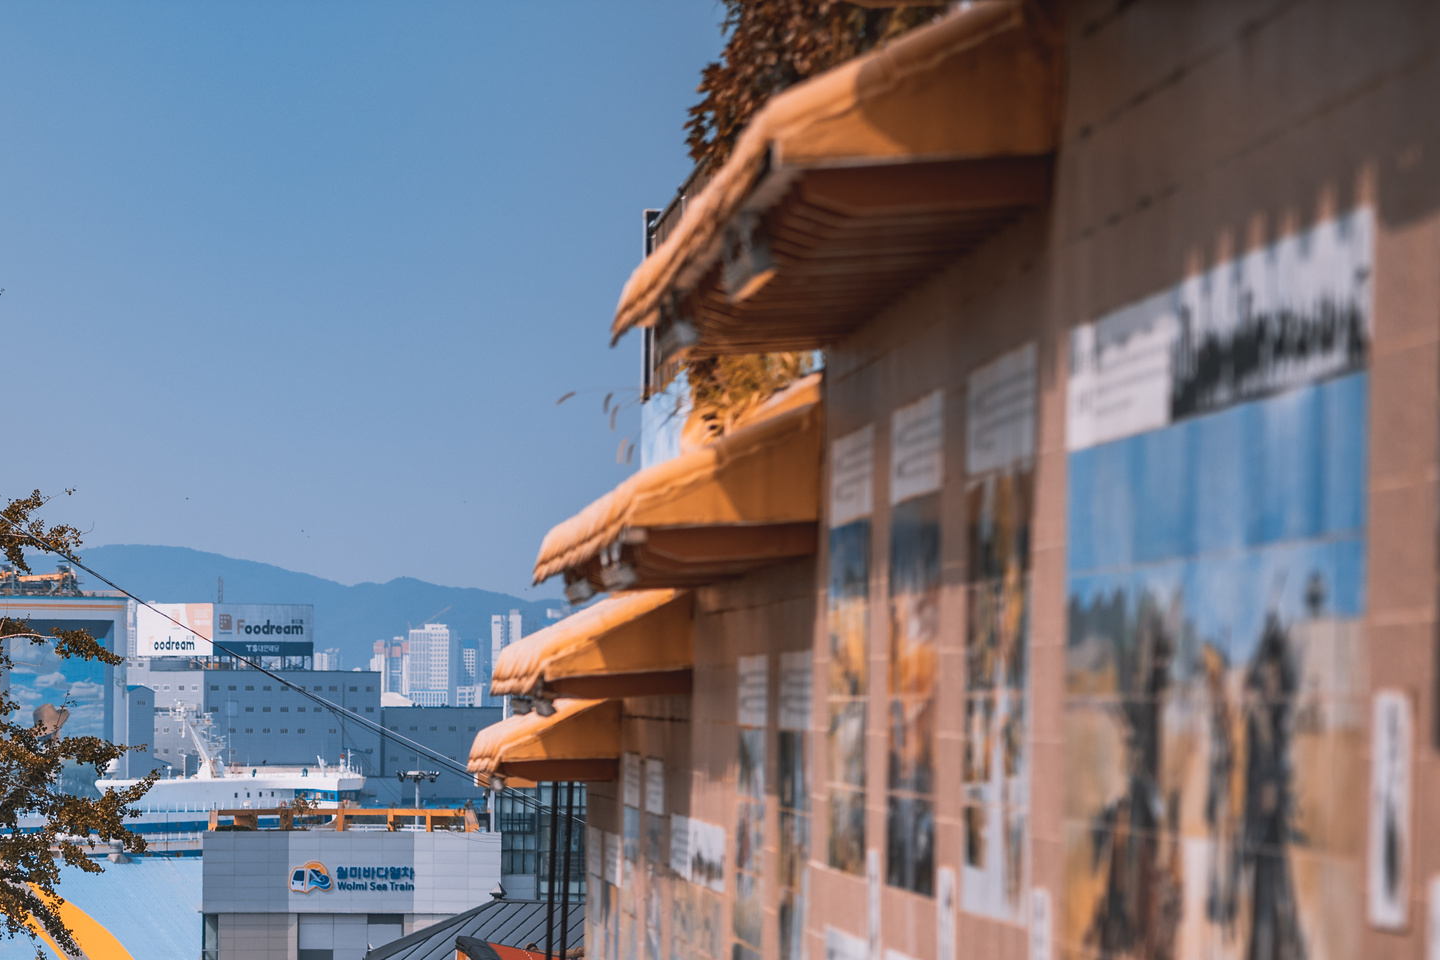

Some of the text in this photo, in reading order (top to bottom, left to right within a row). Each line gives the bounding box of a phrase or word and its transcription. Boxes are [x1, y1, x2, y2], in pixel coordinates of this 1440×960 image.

[237, 619, 304, 635] Foodream
[336, 866, 416, 880] 월미바다열차
[337, 881, 415, 892] Wolmi Sea Train
